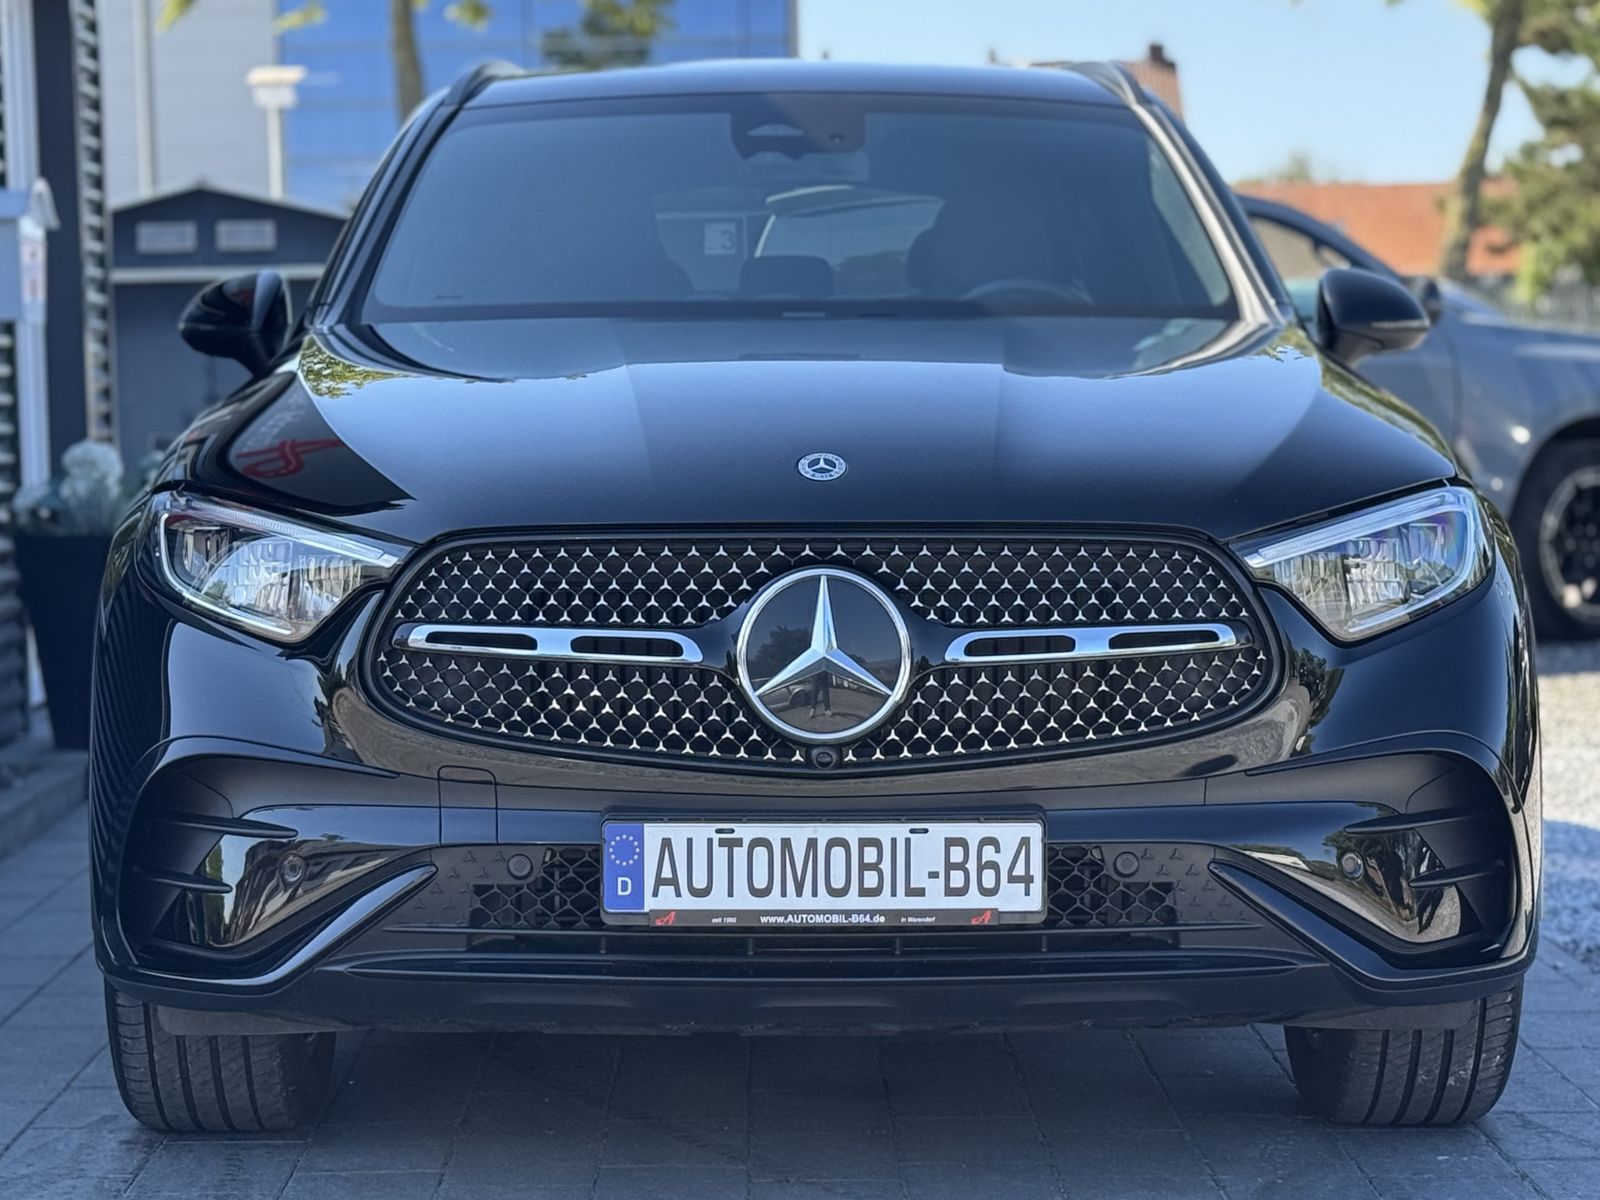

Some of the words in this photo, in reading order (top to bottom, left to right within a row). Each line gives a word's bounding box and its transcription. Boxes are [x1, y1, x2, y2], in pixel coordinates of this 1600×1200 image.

[652, 836, 1035, 898] AUTOMOBIL-B64
[617, 876, 632, 896] D
[759, 913, 886, 924] www.AUTOMOBIL-B64.de
